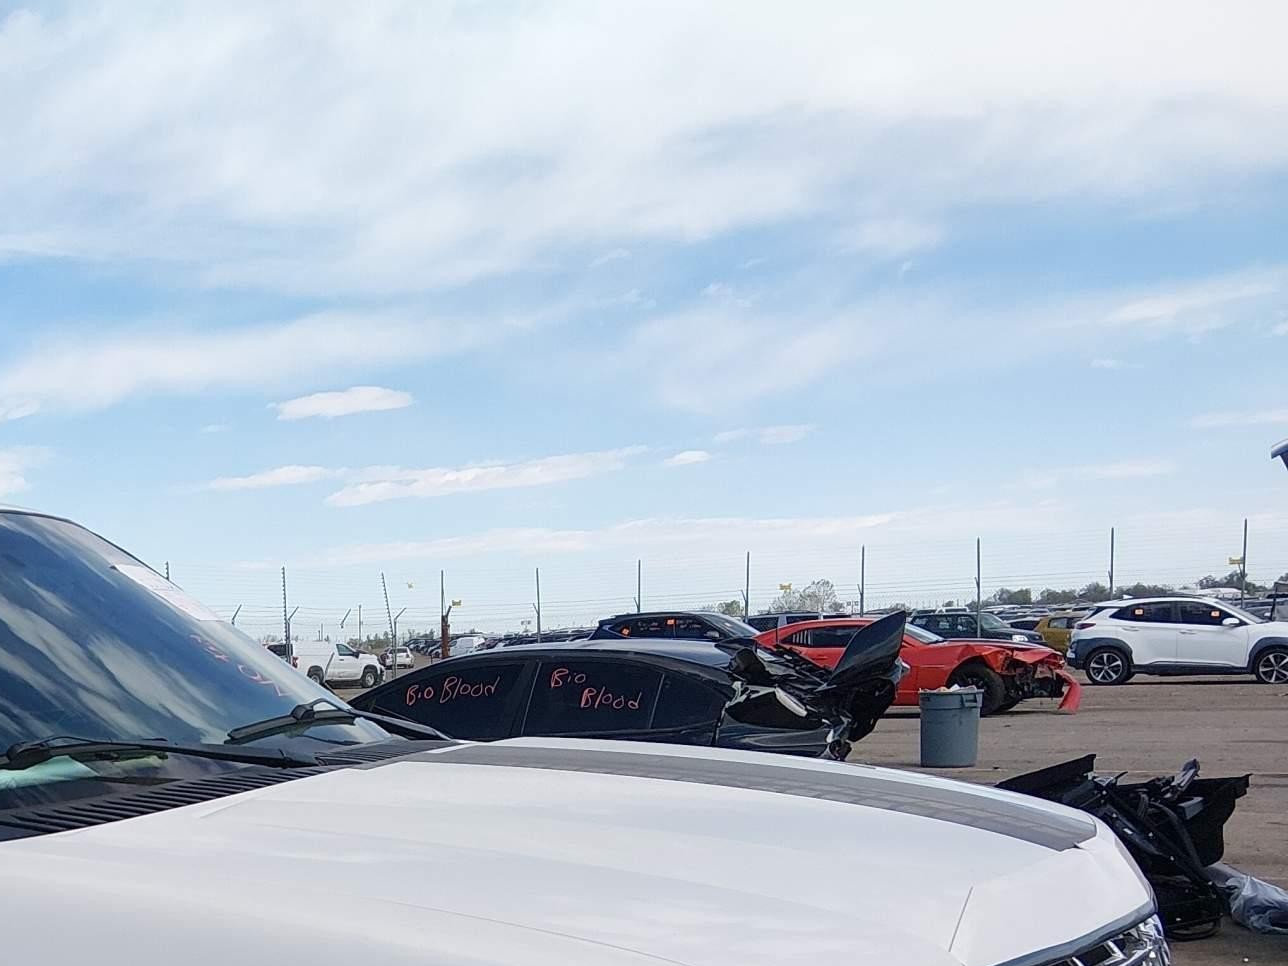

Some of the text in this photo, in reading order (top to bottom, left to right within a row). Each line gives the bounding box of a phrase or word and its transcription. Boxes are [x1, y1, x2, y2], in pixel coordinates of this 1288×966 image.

[549, 668, 587, 689] Bio
[405, 676, 501, 706] Bio Blood
[579, 686, 642, 710] Blood
